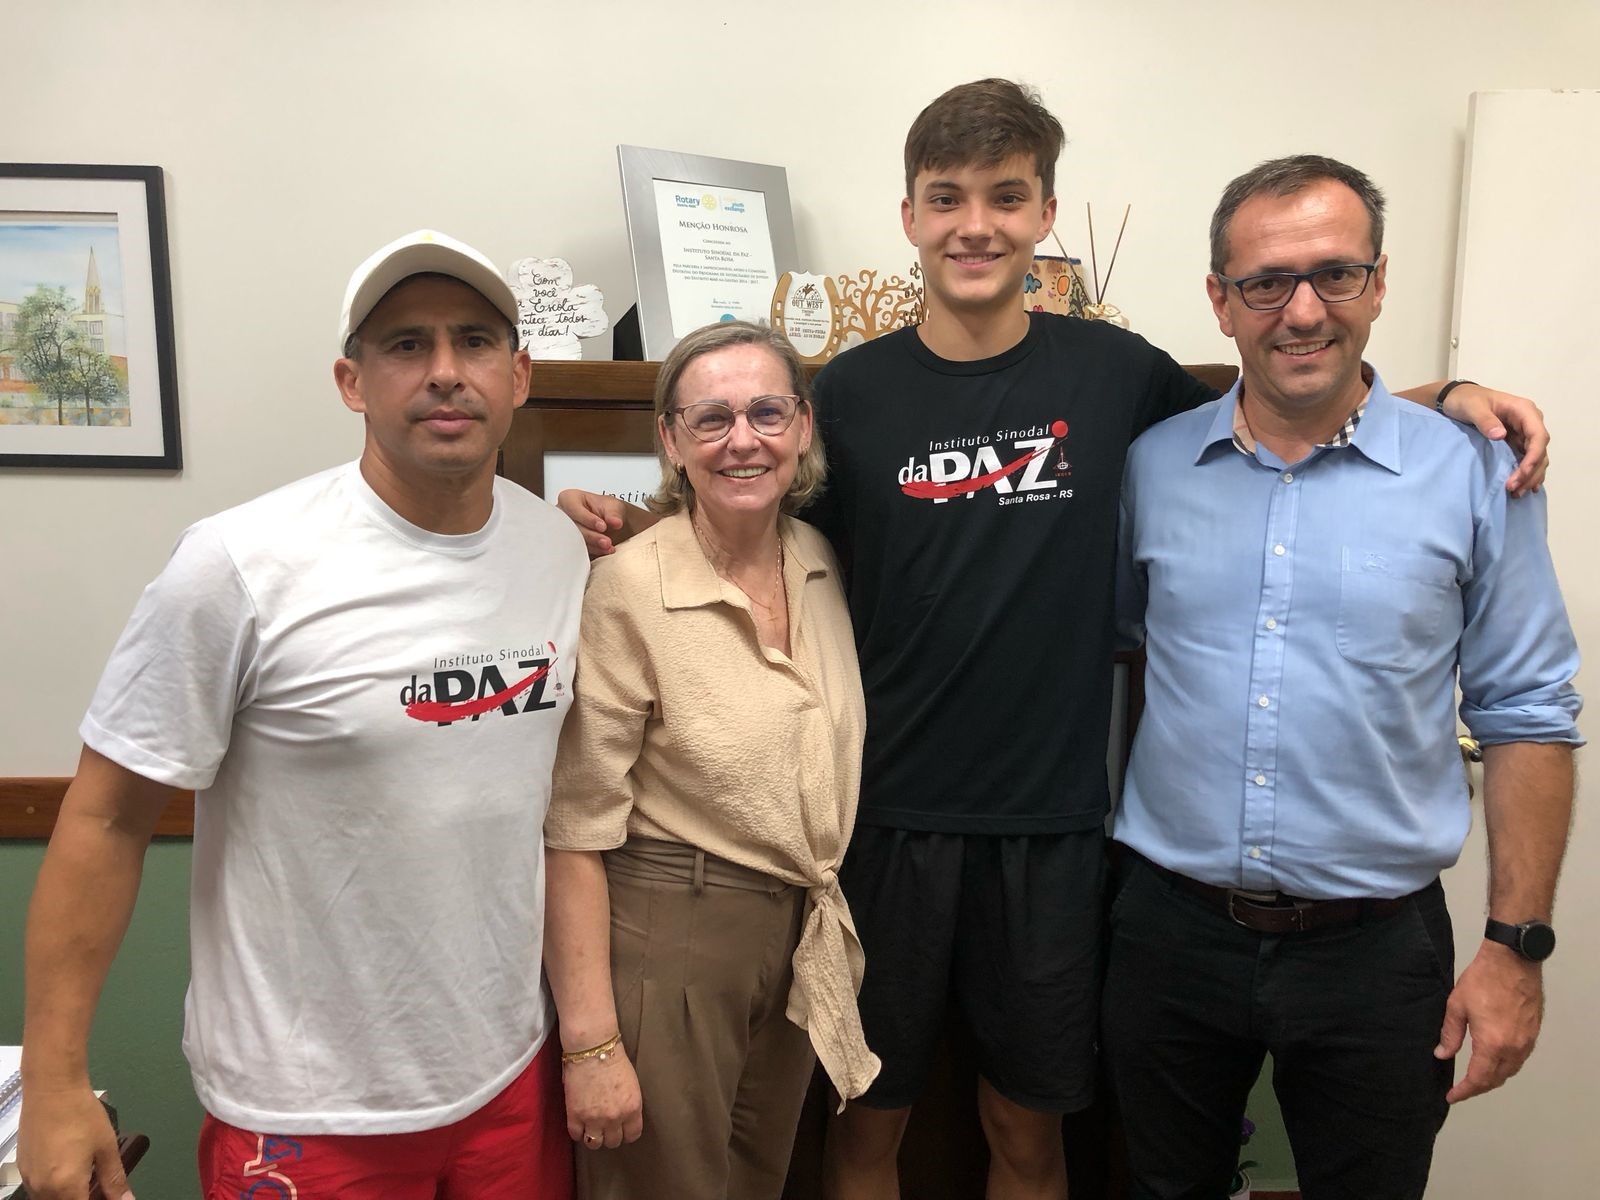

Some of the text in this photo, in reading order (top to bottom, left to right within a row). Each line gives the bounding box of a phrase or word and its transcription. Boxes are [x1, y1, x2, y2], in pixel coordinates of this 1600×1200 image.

[675, 195, 700, 206] Rotary
[679, 219, 748, 234] MENÇÃO HONROSA
[683, 247, 710, 255] INSTITUTO
[531, 269, 559, 286] Com
[533, 288, 558, 298] você
[529, 298, 578, 313] Escola
[791, 300, 824, 310] OUT WEST
[520, 312, 590, 325] ntece todos
[929, 424, 1050, 452] Instituto Sinodal
[601, 490, 657, 503] Instit
[998, 496, 1023, 506] Santa
[1025, 492, 1050, 503] Rosa
[1059, 489, 1073, 499] RS
[434, 644, 544, 669] Instituto Sinodal
